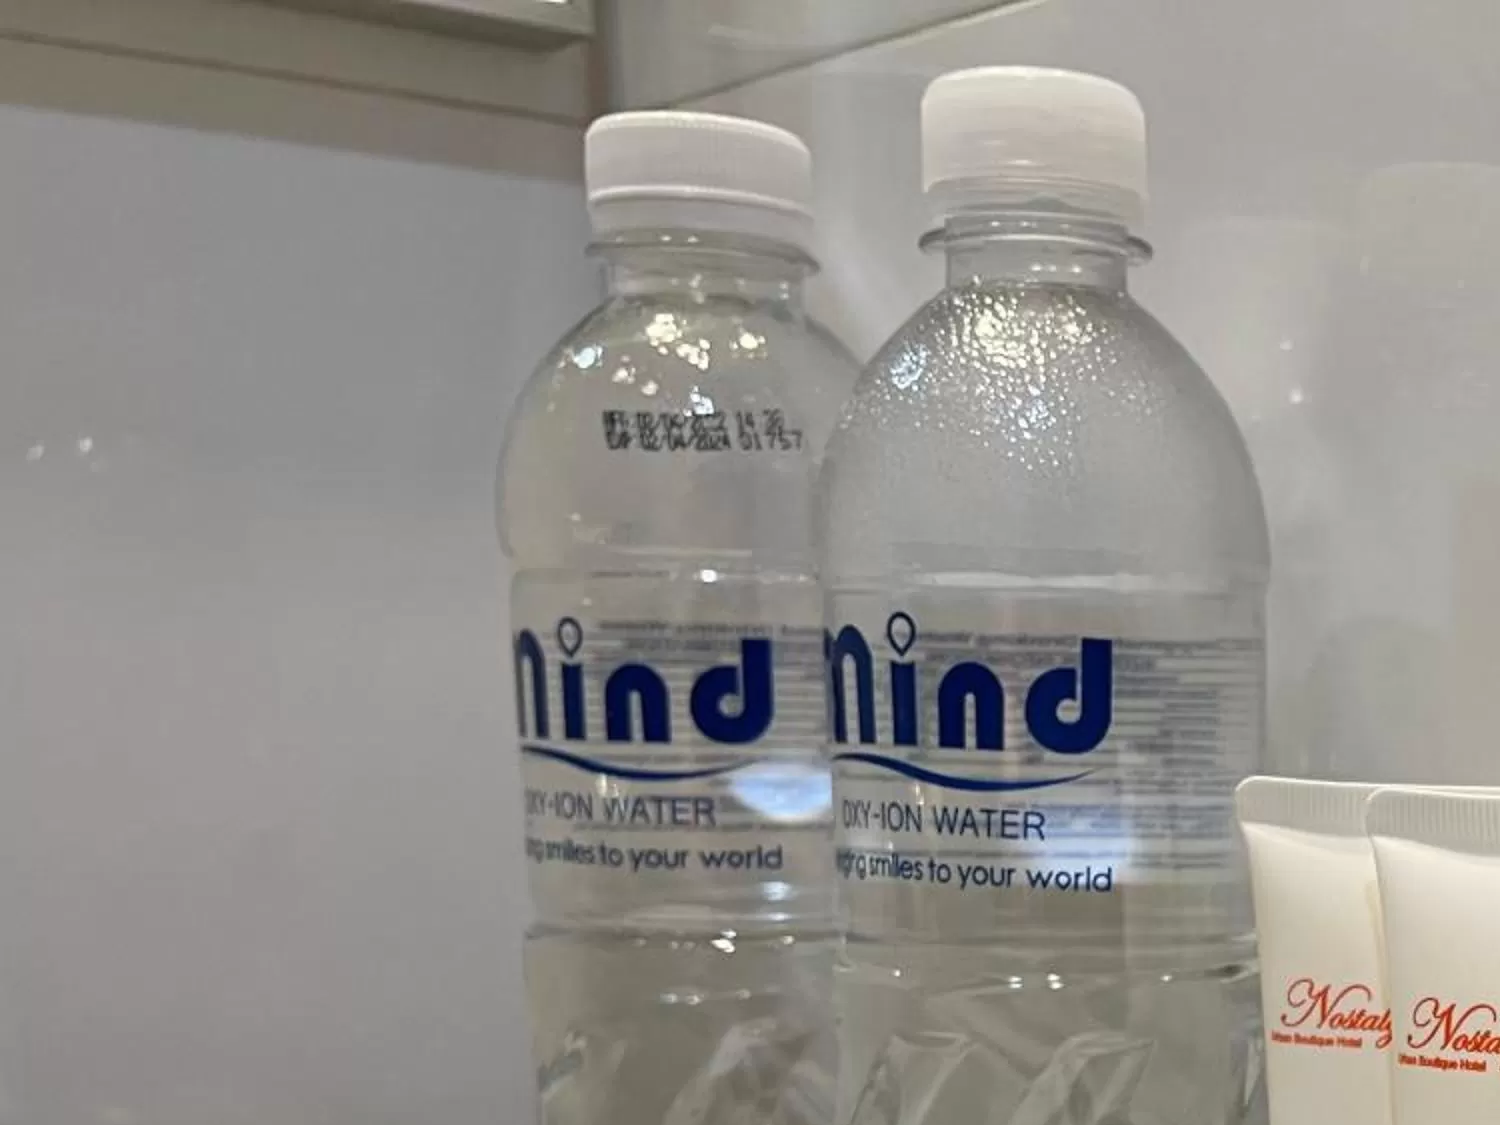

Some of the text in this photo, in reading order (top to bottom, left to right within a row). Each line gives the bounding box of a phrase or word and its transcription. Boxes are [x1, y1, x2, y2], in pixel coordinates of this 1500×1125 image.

[602, 797, 717, 827] WATER
[842, 799, 1047, 841] OXY-ION WATER
[599, 840, 624, 869] to
[630, 846, 689, 873] your
[701, 844, 784, 870] world
[927, 856, 951, 884] to
[957, 864, 1016, 892] your
[1026, 866, 1113, 893] world
